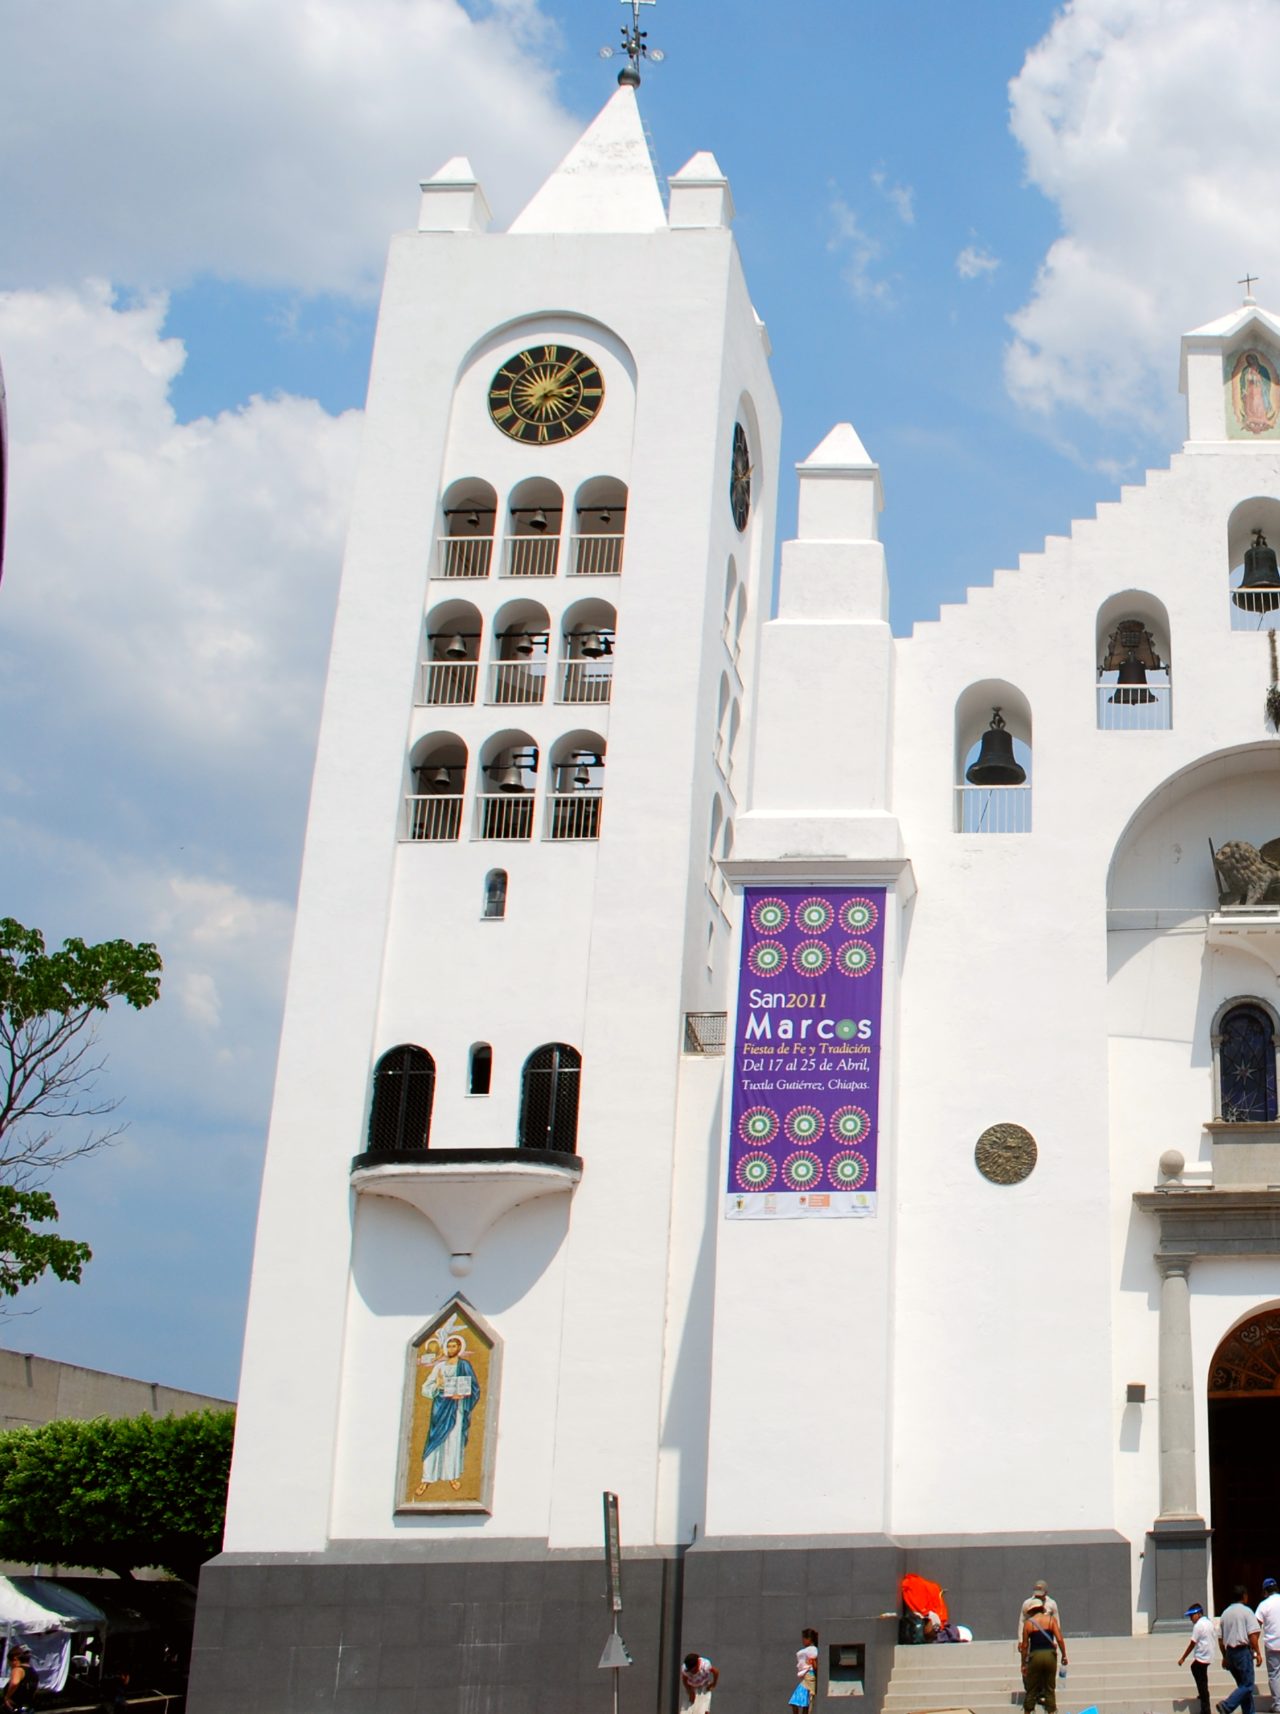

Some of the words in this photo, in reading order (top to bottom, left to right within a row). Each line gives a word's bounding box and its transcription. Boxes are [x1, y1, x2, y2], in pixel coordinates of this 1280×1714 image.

[748, 988, 786, 1009] San
[785, 993, 827, 1009] 2011
[742, 1043, 775, 1055] Fiesta
[776, 1043, 790, 1055] de
[792, 1043, 807, 1055] Fe
[808, 1046, 817, 1057] y
[818, 1042, 872, 1055] Tradición
[742, 1058, 764, 1072] Del
[768, 1059, 784, 1072] 17
[785, 1058, 798, 1072] al
[800, 1059, 817, 1072] 25
[819, 1058, 834, 1072] de
[836, 1058, 871, 1073] Abril,
[742, 1079, 774, 1091] Tuxtla
[776, 1078, 826, 1092] Gutiérrez,
[827, 1078, 871, 1093] Chiapas.
